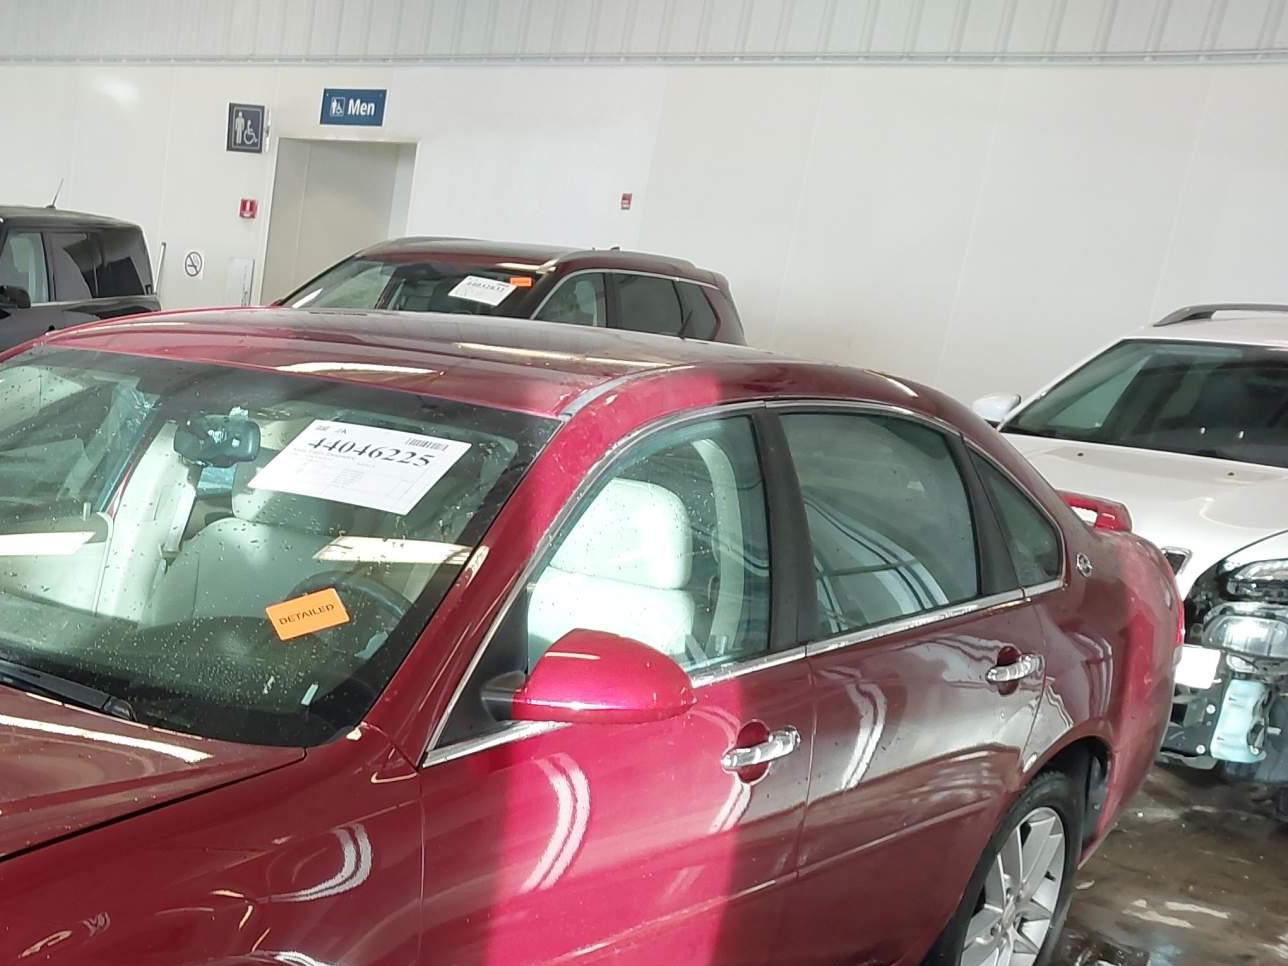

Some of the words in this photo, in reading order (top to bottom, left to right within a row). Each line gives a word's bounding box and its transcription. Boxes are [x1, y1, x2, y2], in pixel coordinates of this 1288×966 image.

[347, 98, 376, 116] Men
[308, 437, 436, 468] 44046225
[277, 603, 335, 625] DETAILED
